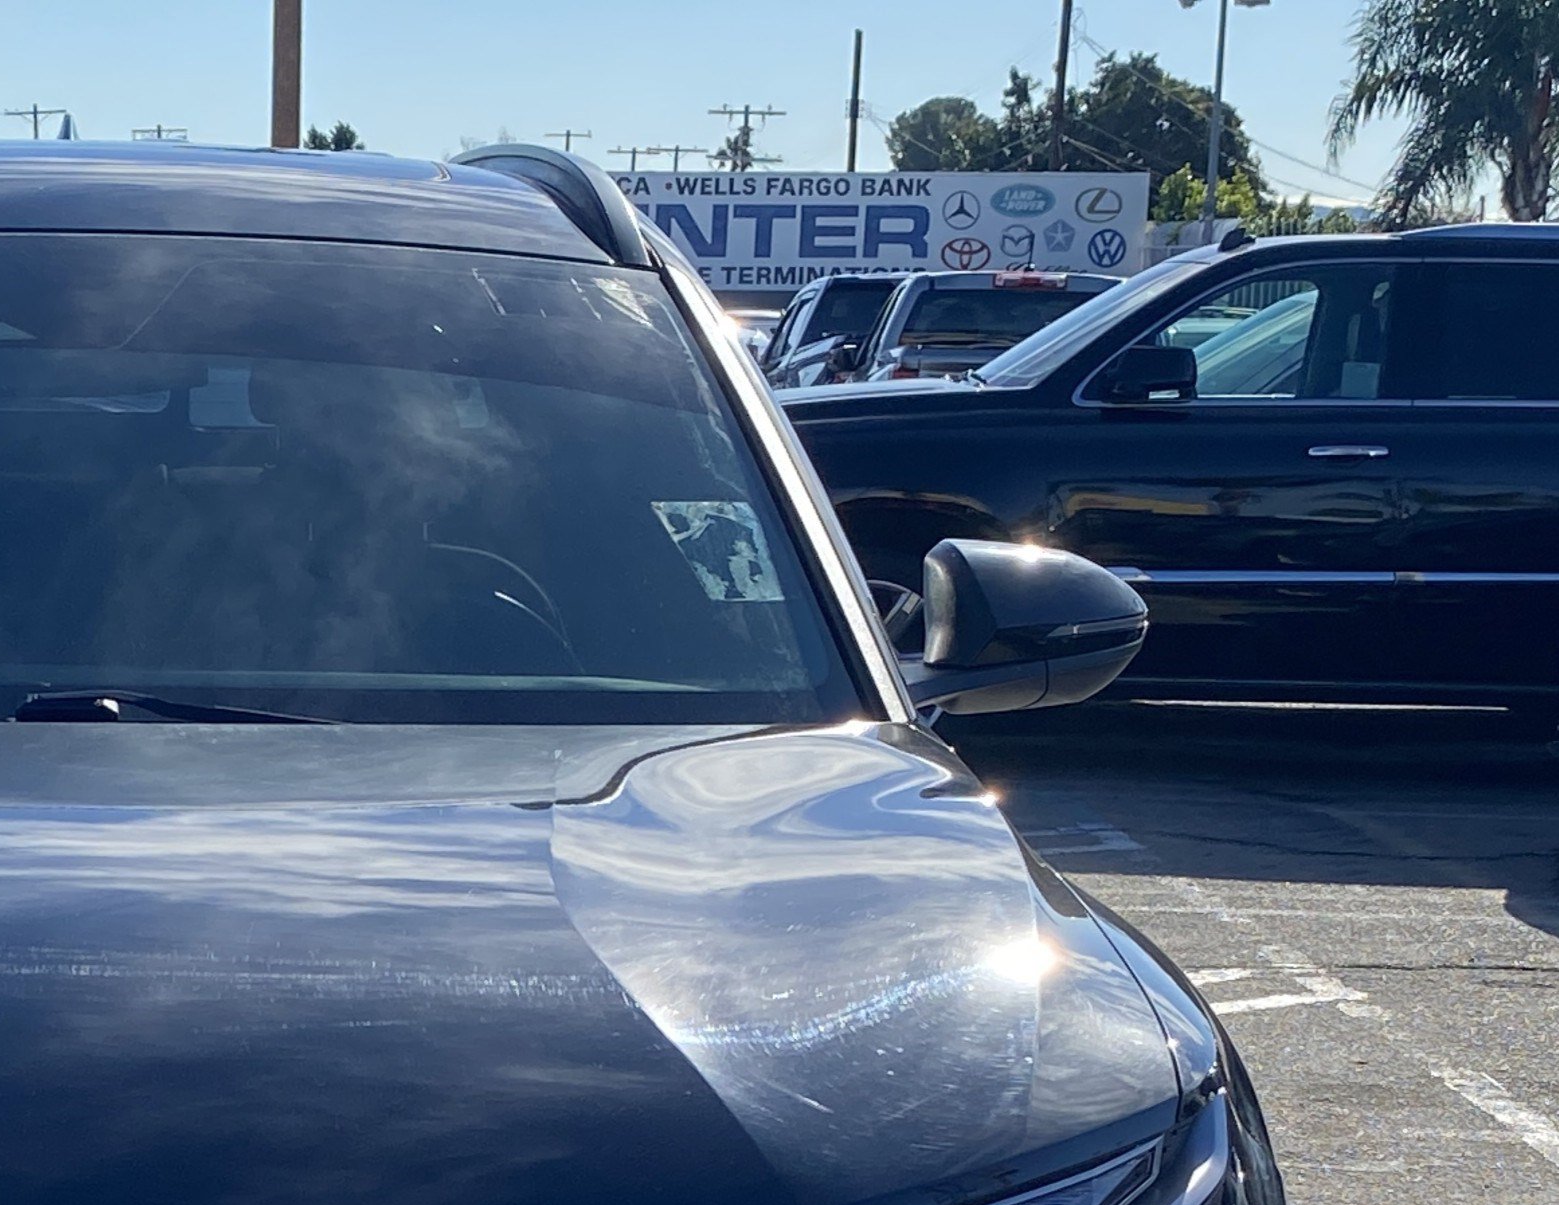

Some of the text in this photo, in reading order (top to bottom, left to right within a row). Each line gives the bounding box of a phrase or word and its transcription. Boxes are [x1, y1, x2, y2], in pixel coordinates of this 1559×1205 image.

[676, 177, 757, 196] WELLS
[766, 177, 851, 197] FARGO
[861, 178, 932, 197] BANK
[1004, 189, 1037, 200] LAND
[1006, 200, 1046, 211] ROVER
[634, 204, 930, 258] NTER
